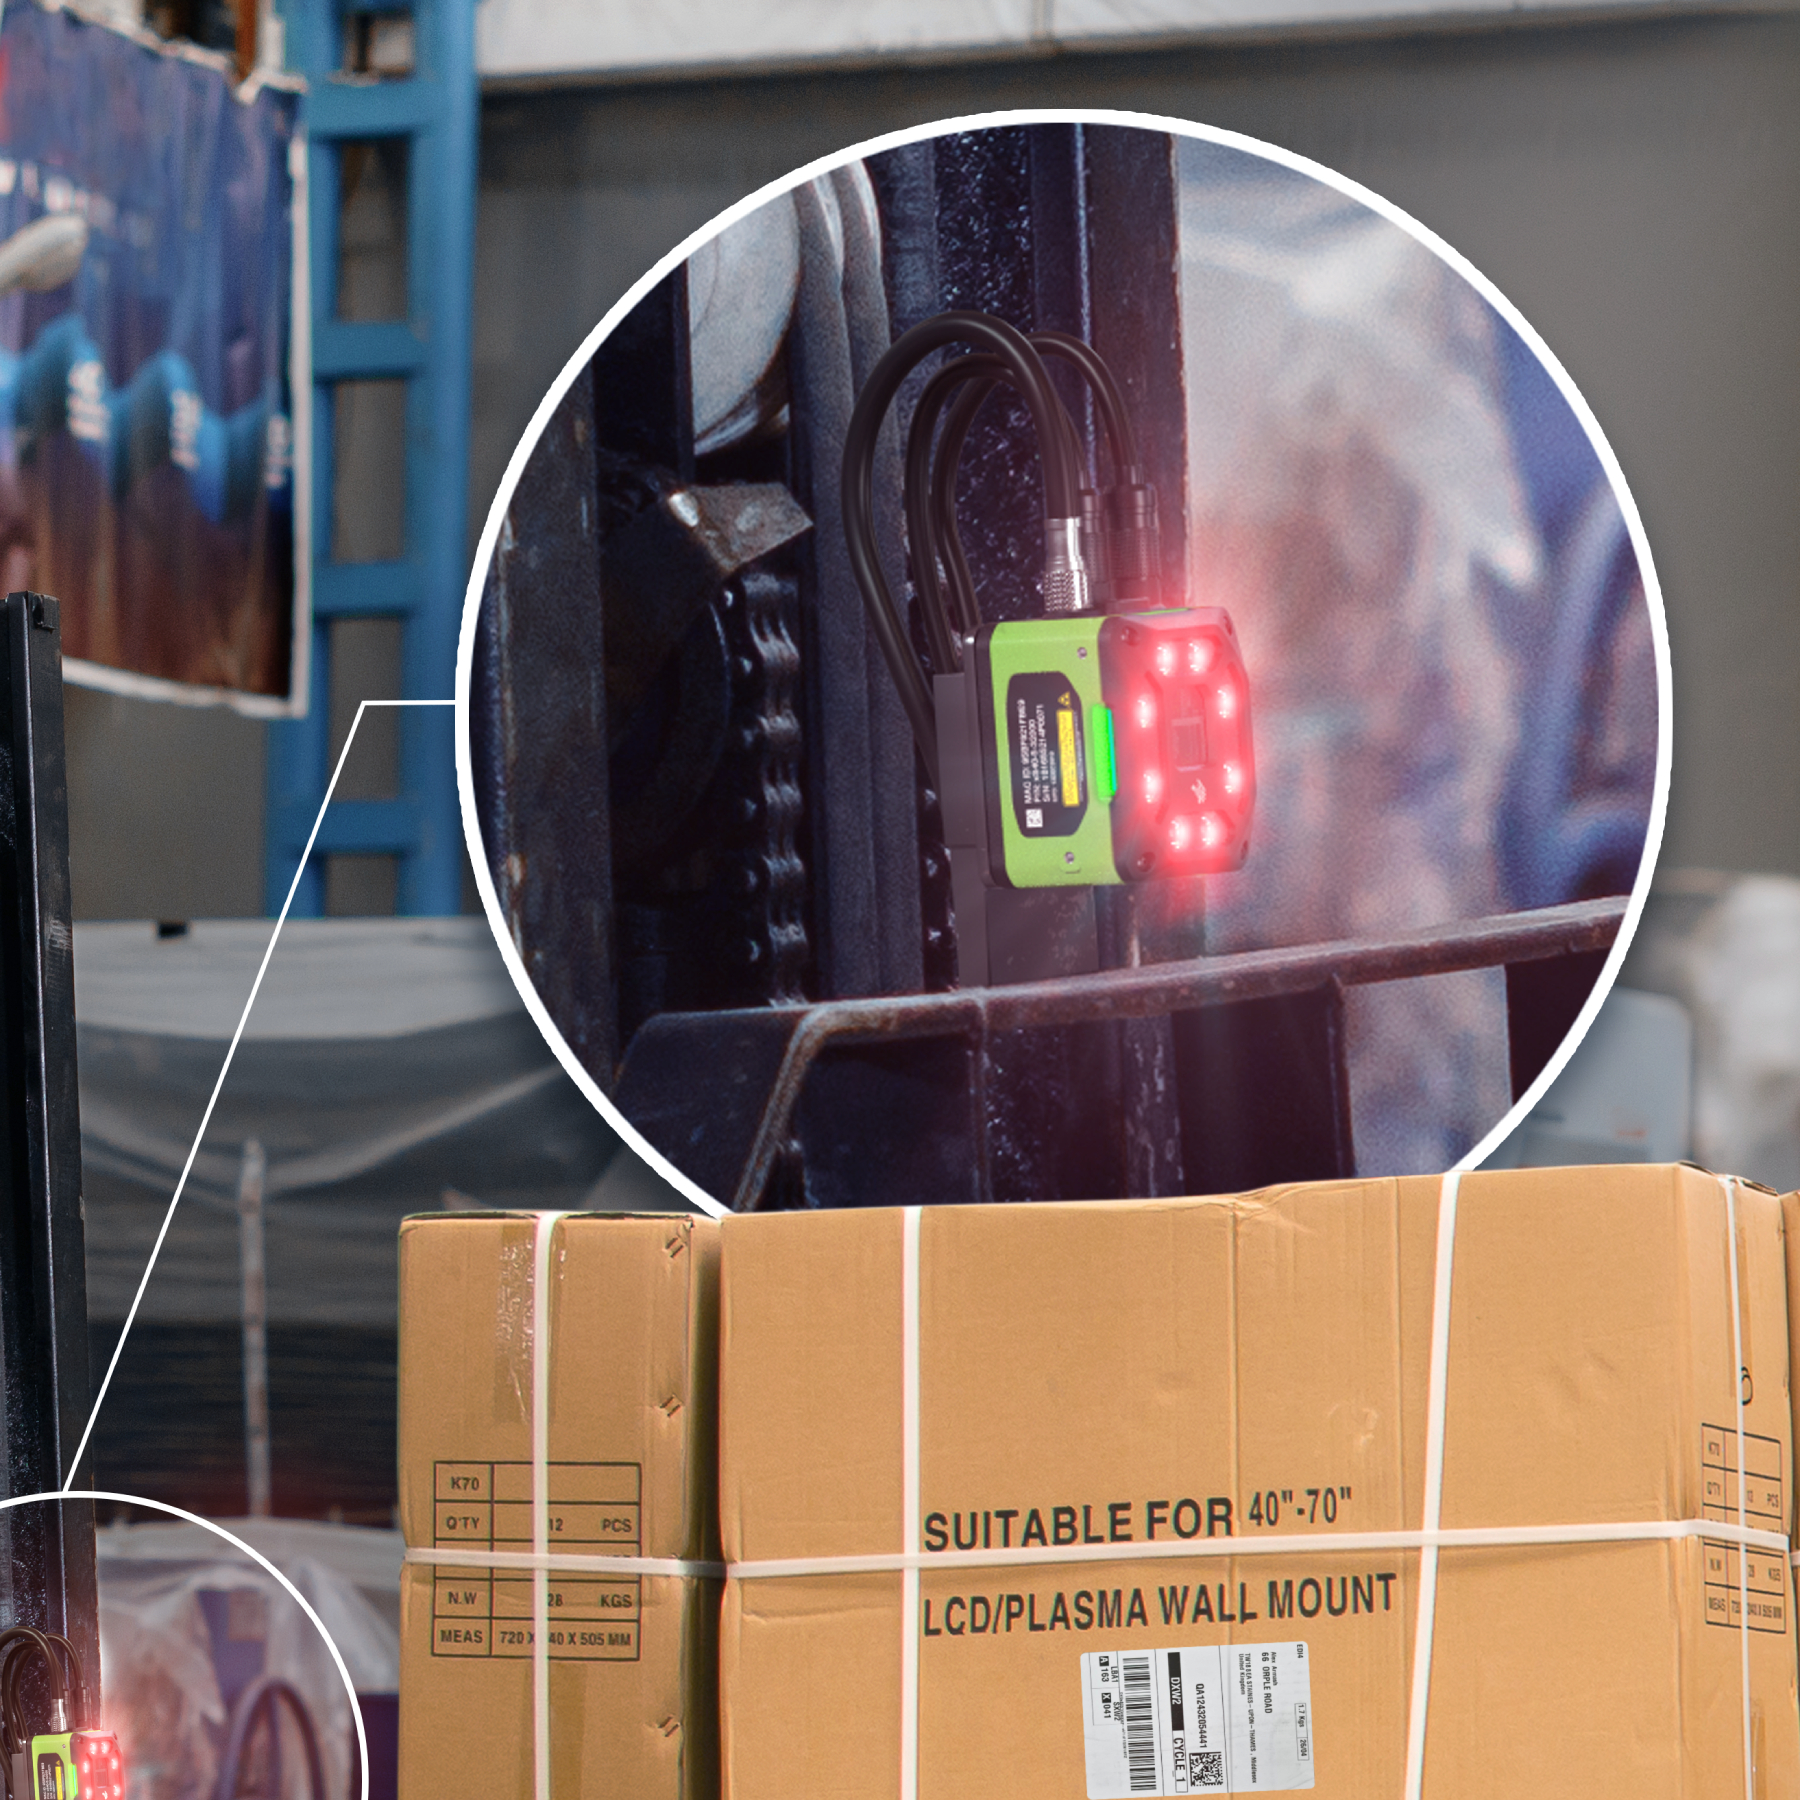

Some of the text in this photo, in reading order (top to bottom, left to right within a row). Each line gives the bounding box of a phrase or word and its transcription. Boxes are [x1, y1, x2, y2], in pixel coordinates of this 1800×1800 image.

[451, 1477, 479, 1490] K70
[446, 1517, 480, 1530] Q'TY
[602, 1519, 632, 1533] PCS
[925, 1502, 1133, 1552] SUITABLE
[1147, 1498, 1233, 1540] FOR
[448, 1592, 477, 1605] N.W
[601, 1594, 633, 1608] KGS
[924, 1573, 1397, 1637] LCD/PLASMA WALL MOUNT
[441, 1630, 483, 1644] MEAS
[501, 1631, 525, 1644] 720
[580, 1633, 605, 1646] 505
[608, 1633, 631, 1646] MM
[1101, 1668, 1110, 1683] 163
[1263, 1667, 1271, 1691] ORPLE
[1171, 1677, 1182, 1705] DXW2
[1264, 1693, 1273, 1714] ROAD
